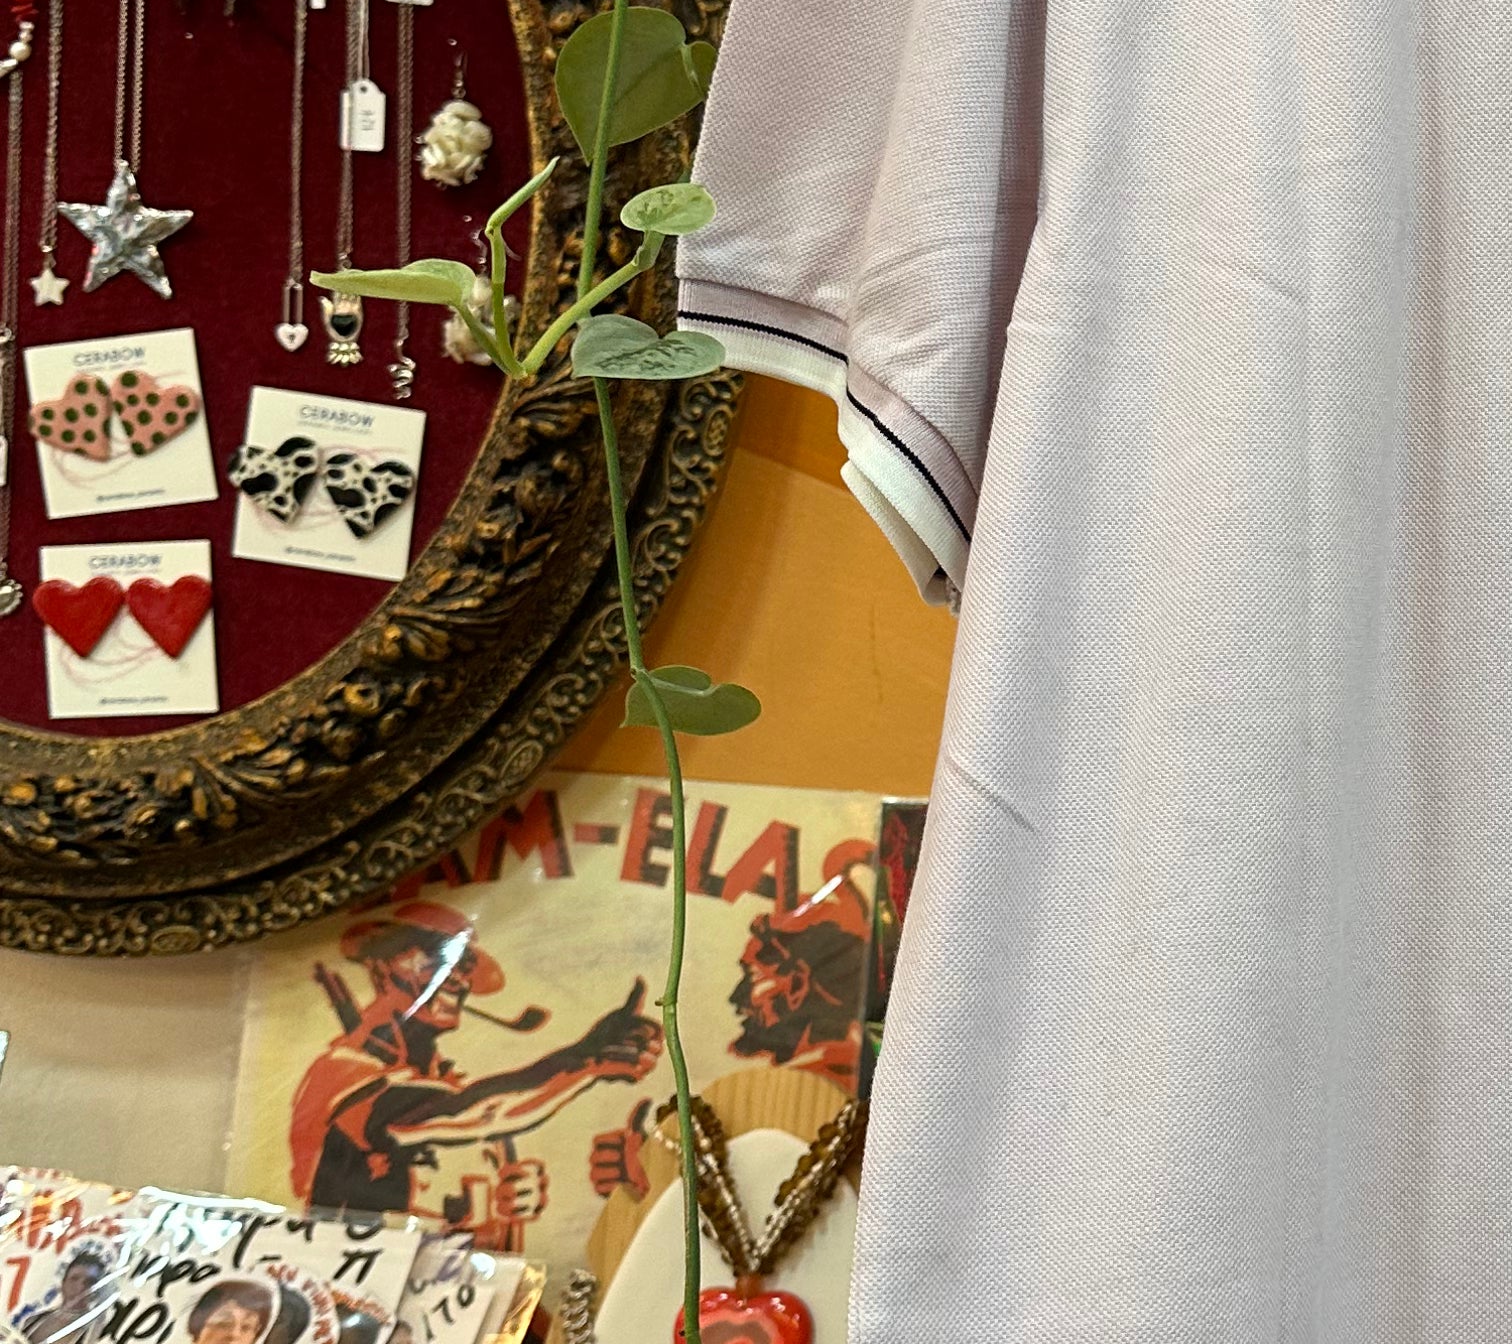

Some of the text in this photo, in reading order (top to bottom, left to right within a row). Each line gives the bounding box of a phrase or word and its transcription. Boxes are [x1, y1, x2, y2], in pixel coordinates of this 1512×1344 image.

[73, 346, 146, 367] CERABOW
[300, 405, 376, 428] CERABOW
[89, 553, 162, 568] CERABOW
